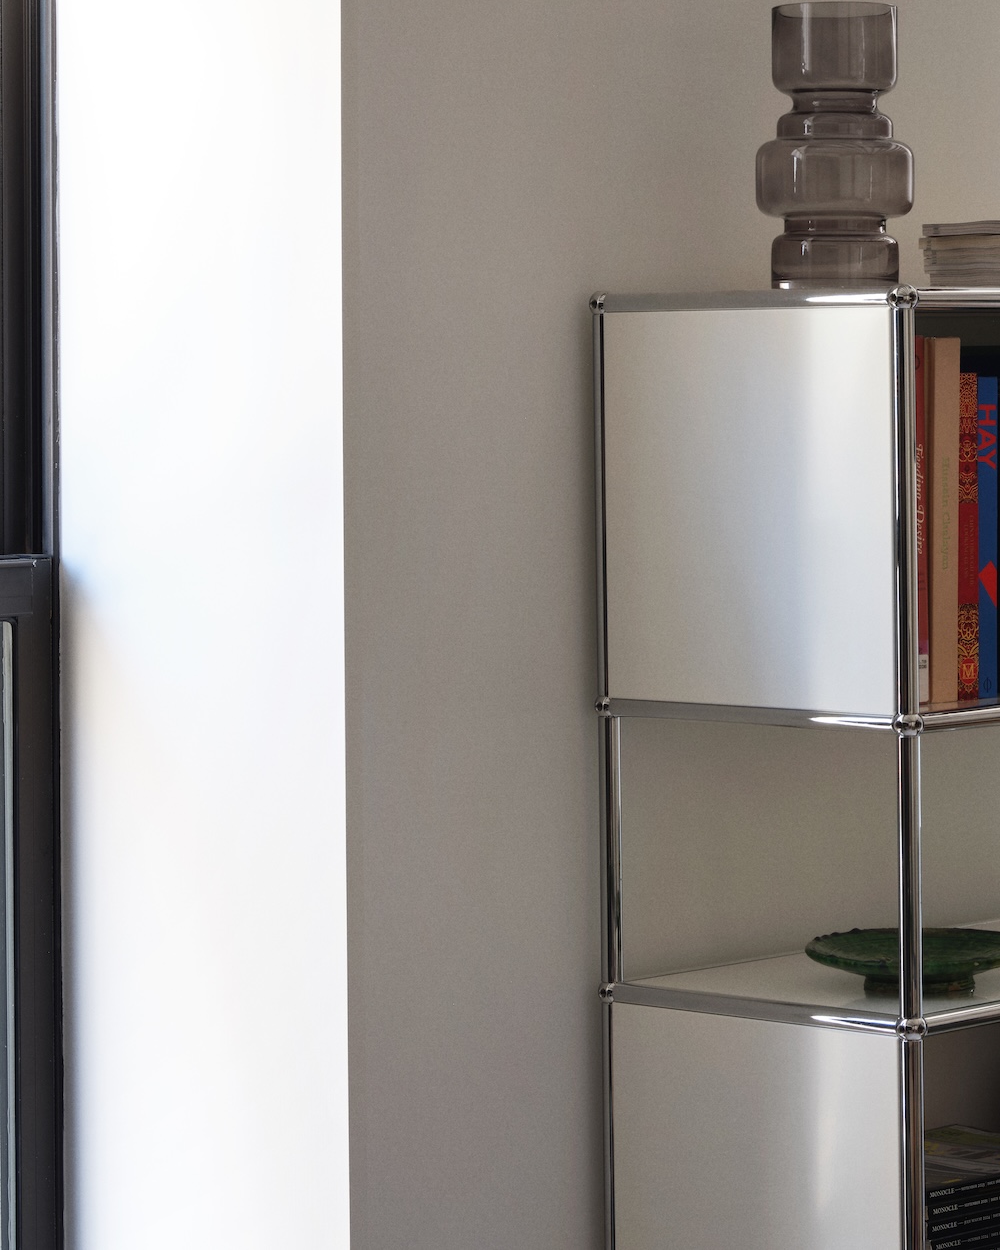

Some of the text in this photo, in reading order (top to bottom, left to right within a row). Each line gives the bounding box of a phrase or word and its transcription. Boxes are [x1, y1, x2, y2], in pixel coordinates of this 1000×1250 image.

[978, 404, 997, 469] HAY
[916, 443, 925, 555] Feeding Desire
[929, 1188, 955, 1198] MONOCLE
[932, 1204, 958, 1215] MONOCLE
[932, 1221, 957, 1232] MONOCLE
[936, 1239, 961, 1250] MONOCLE
